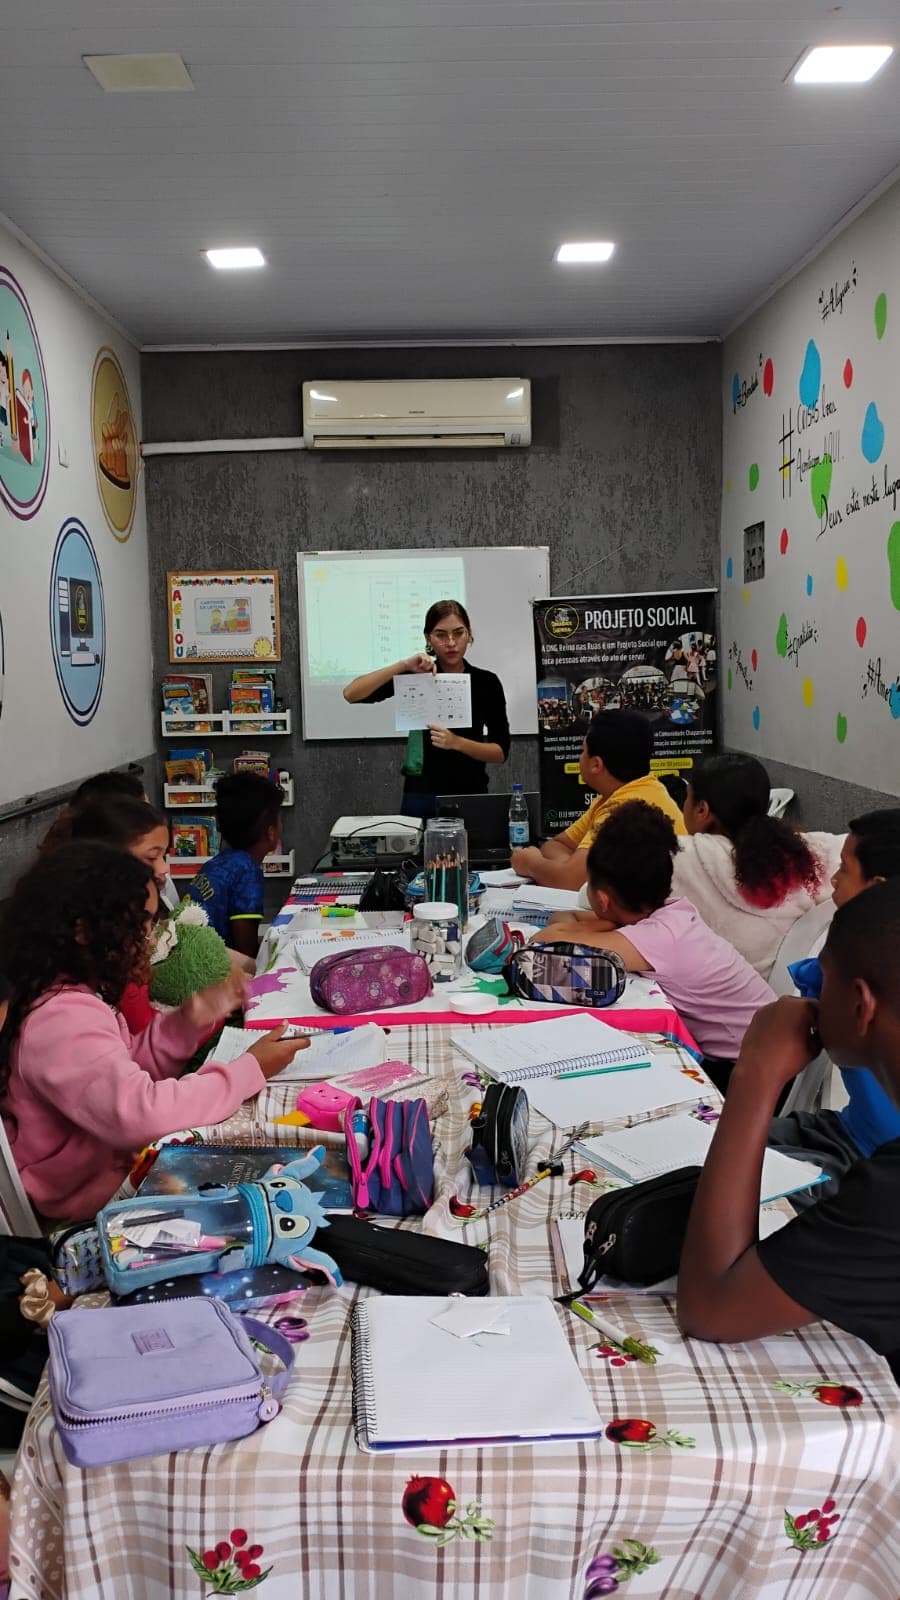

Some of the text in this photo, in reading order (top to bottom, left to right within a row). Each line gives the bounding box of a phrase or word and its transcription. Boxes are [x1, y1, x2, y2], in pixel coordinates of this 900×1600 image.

[816, 493, 843, 542] Deus
[883, 464, 900, 511] luga
[585, 606, 696, 630] PROJETO SOCIAL
[587, 642, 601, 650] Ruas
[616, 640, 637, 650] Projeto
[637, 639, 656, 648] Social
[656, 640, 667, 648] que
[541, 656, 554, 665] toca
[555, 657, 579, 666] pessoas
[579, 655, 601, 663] através
[601, 653, 609, 661] do
[620, 652, 627, 661] de
